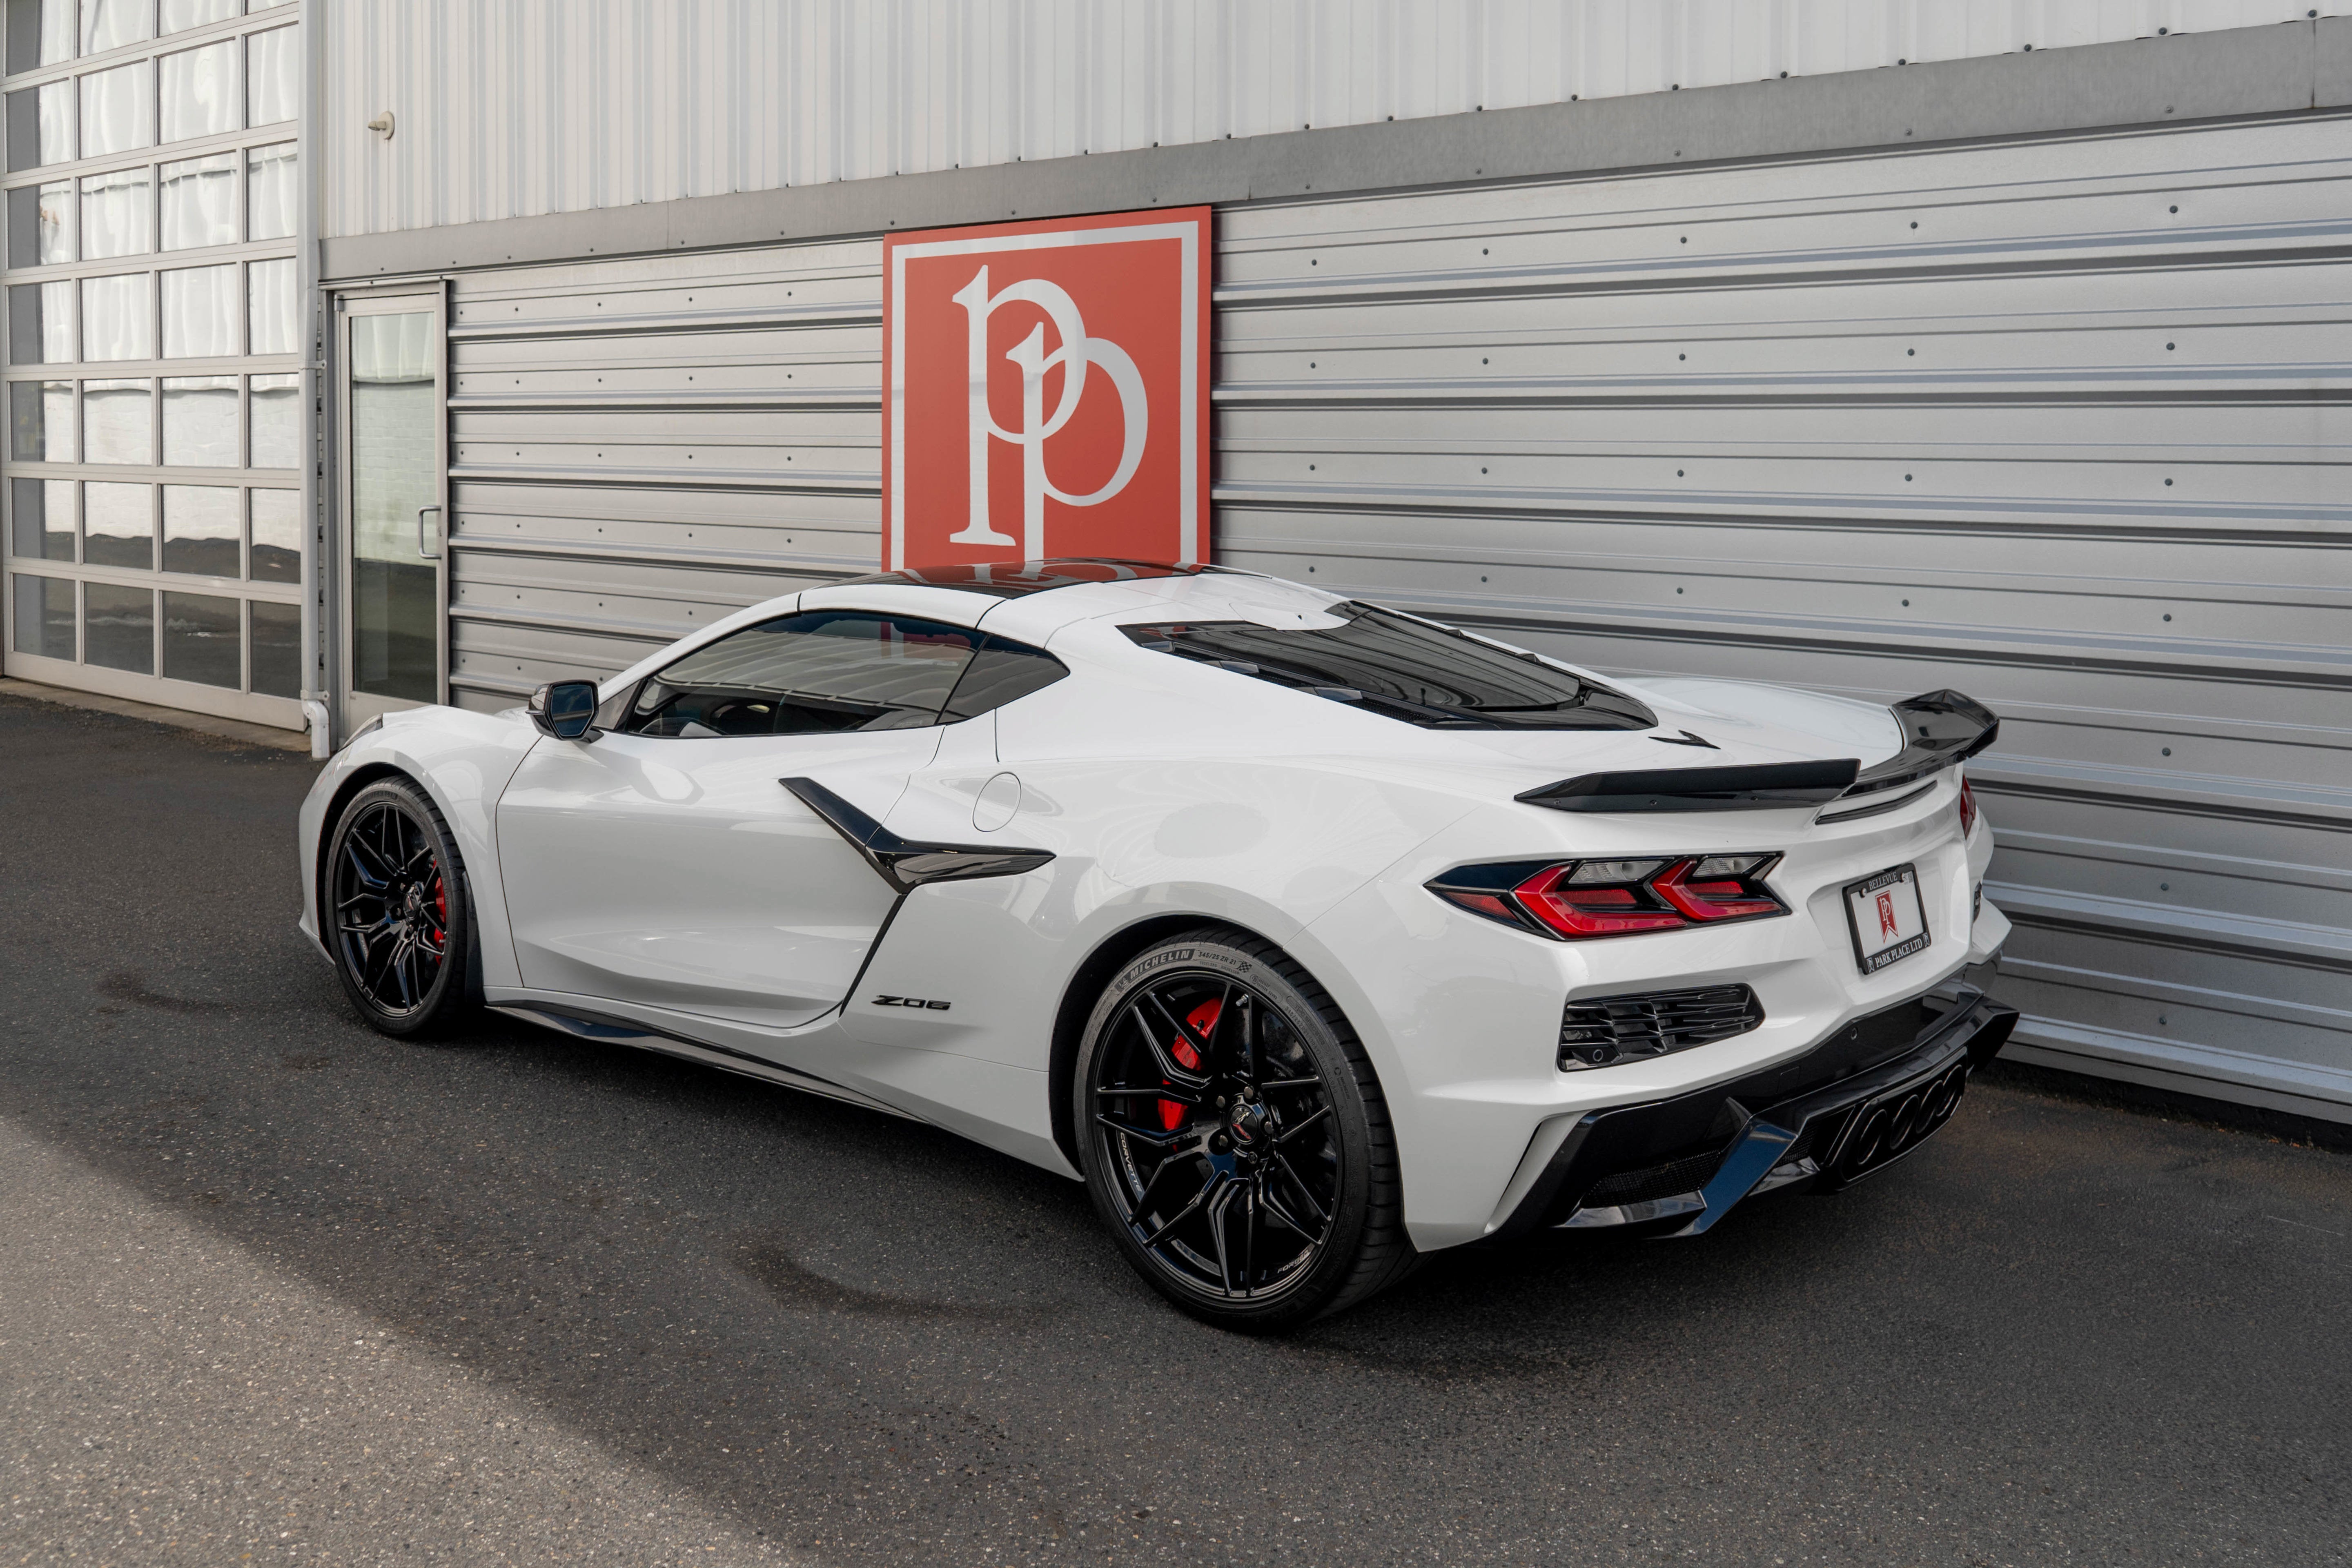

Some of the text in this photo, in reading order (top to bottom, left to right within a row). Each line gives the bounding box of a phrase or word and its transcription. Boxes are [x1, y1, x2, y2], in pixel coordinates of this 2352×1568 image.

[1869, 871, 1898, 890] BELLEVUE
[1130, 950, 1190, 979] MICHELIN
[1198, 952, 1220, 960] 345/25
[1875, 952, 1892, 967] PARK
[1890, 943, 1910, 961] PLACE
[1910, 938, 1923, 952] LTD
[871, 995, 951, 1010] Z06
[1120, 1132, 1143, 1192] CORVETTE
